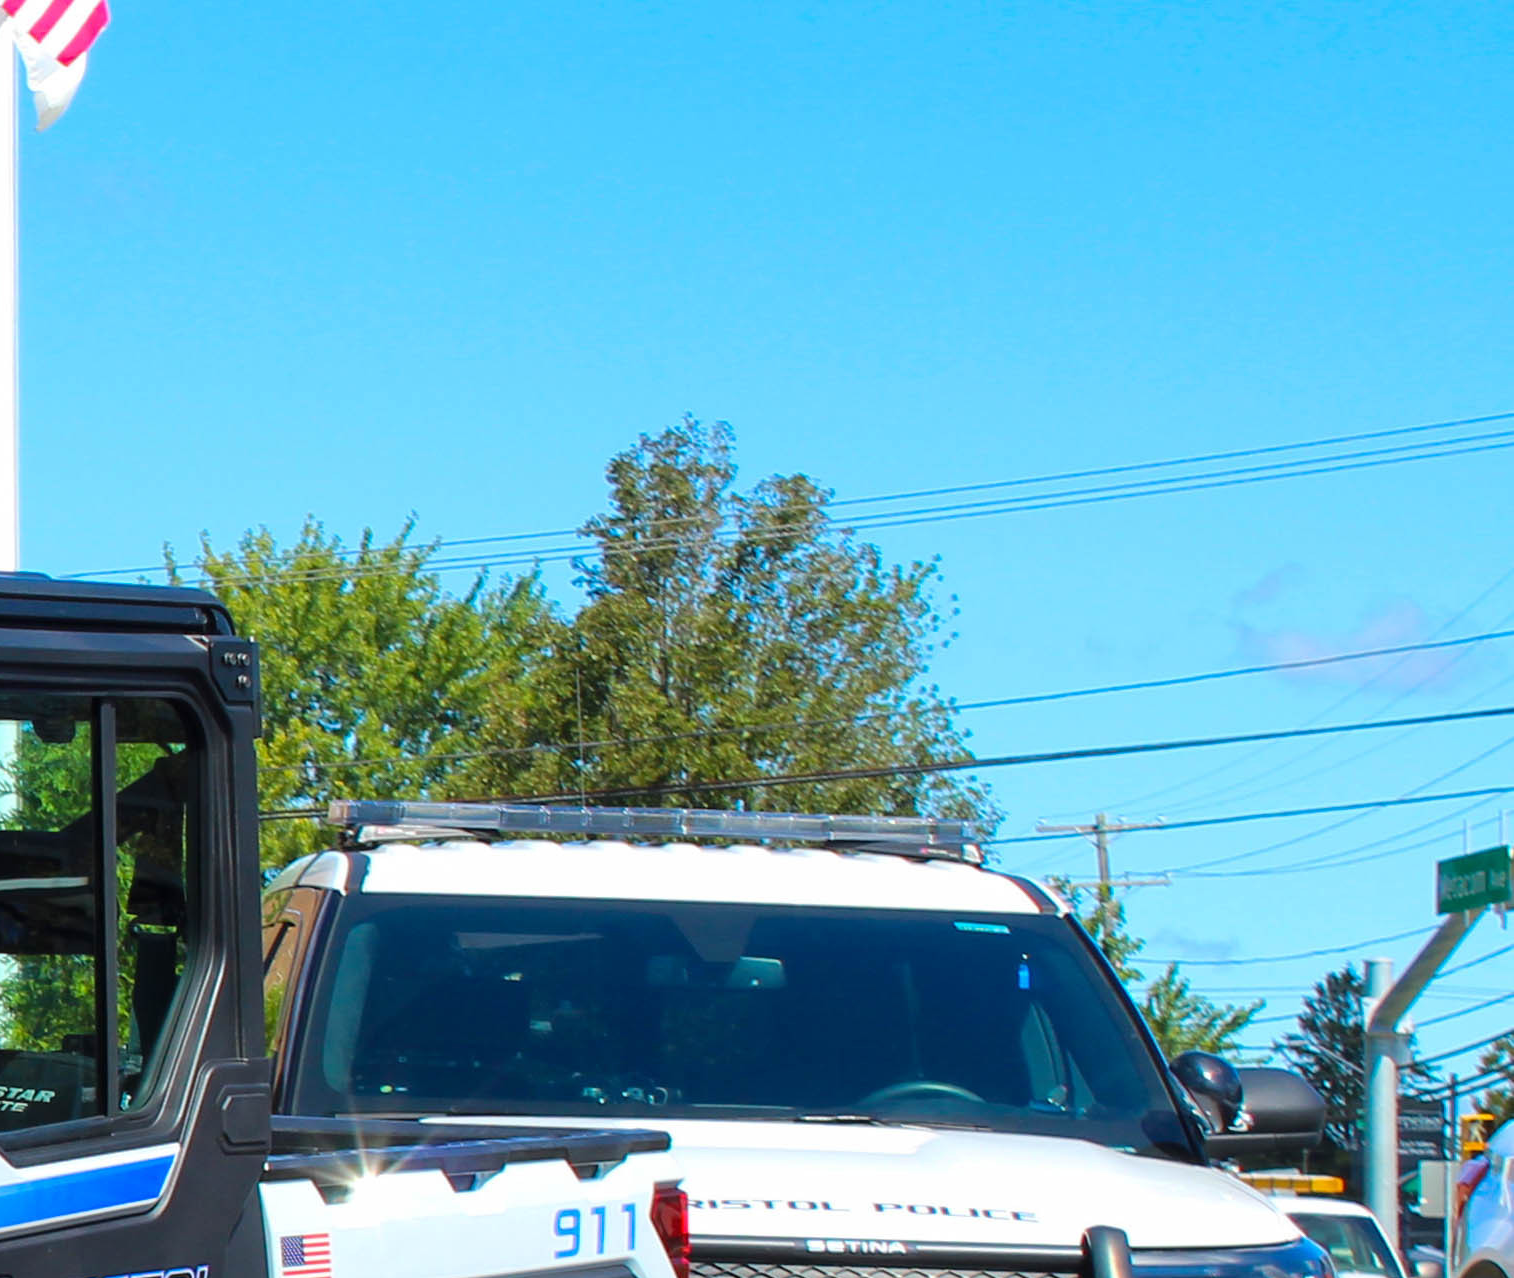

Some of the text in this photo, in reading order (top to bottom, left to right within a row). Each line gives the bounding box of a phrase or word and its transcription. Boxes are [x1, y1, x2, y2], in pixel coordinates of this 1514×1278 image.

[686, 1199, 1039, 1223] RISTOL POLICE
[554, 1203, 637, 1259] 911
[805, 1239, 907, 1254] SETINA
